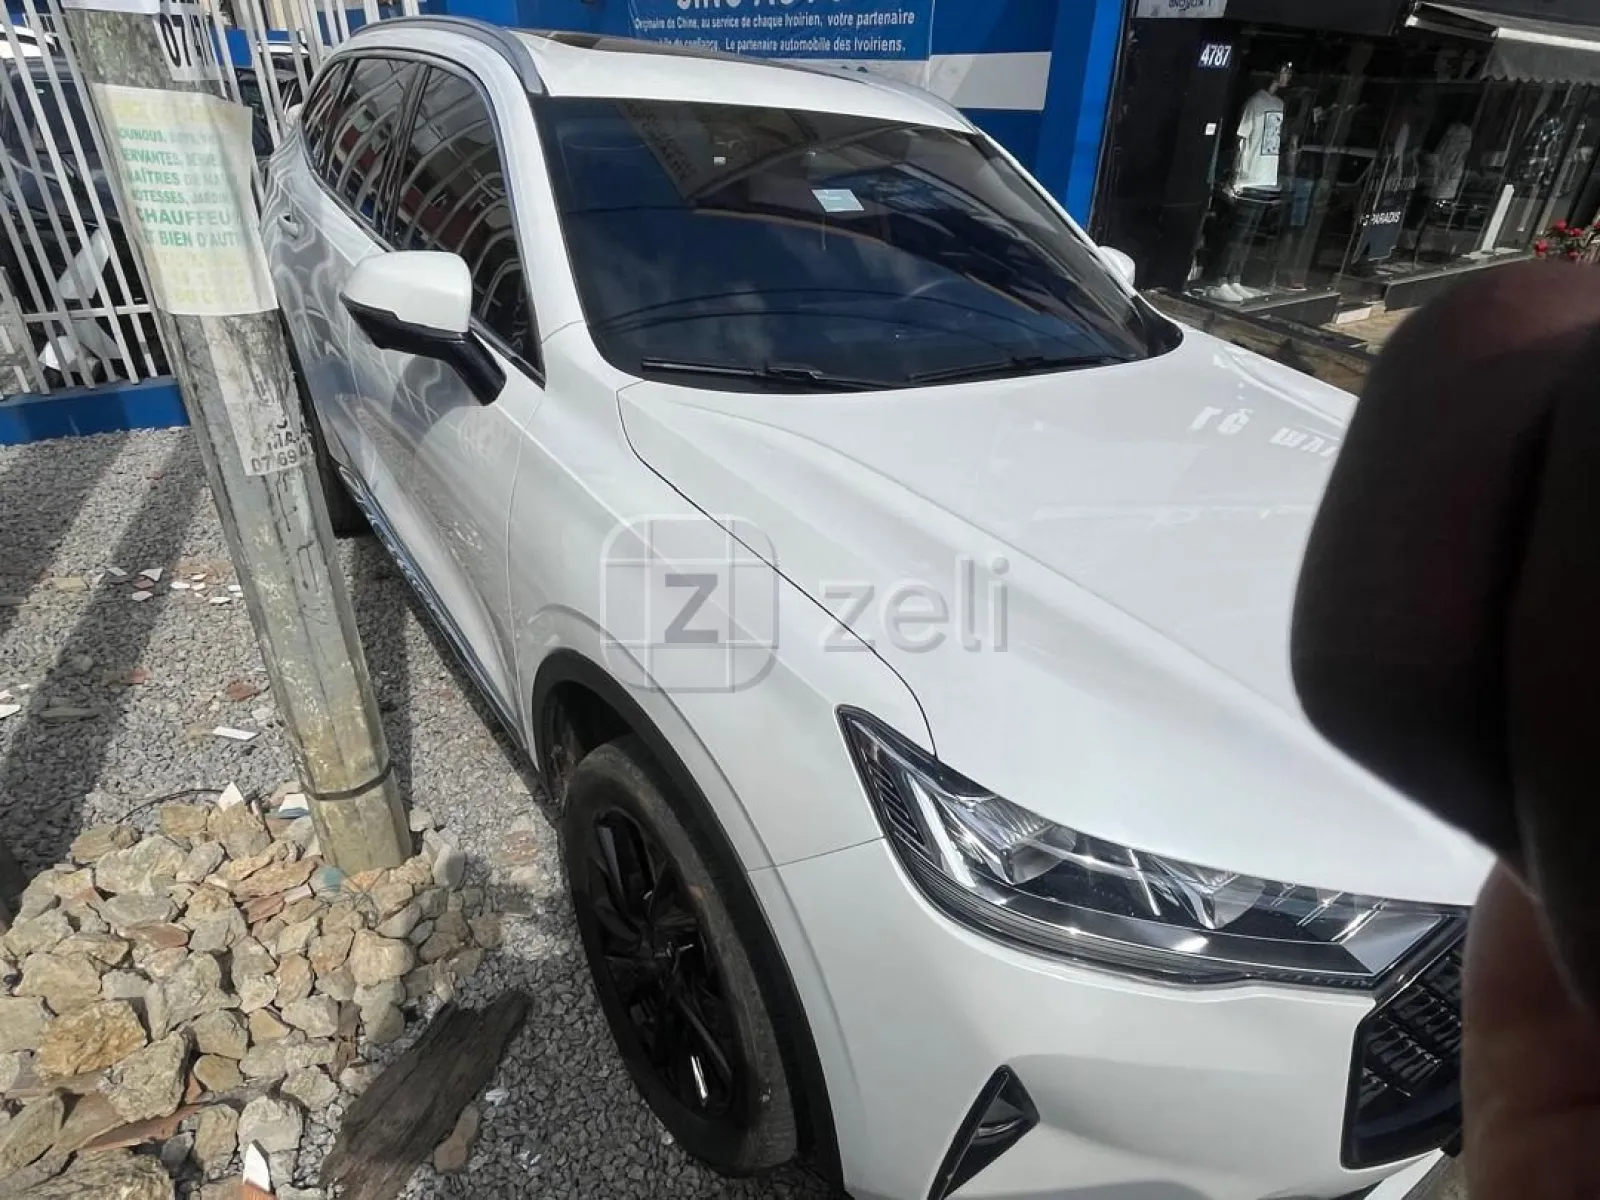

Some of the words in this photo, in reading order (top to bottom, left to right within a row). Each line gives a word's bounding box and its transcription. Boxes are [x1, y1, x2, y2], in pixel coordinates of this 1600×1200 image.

[712, 17, 739, 28] service
[741, 15, 750, 28] de
[753, 14, 783, 29] chaque
[784, 11, 823, 27] Ivoirien,
[827, 12, 854, 26] votre
[856, 9, 915, 28] partenaire
[725, 37, 735, 50] Le
[737, 37, 778, 54] partenaire
[780, 37, 831, 50] automobile
[833, 37, 851, 51] des
[854, 36, 906, 52] Ivoiriens.
[1200, 44, 1232, 67] 4787
[160, 230, 193, 247] BIEN
